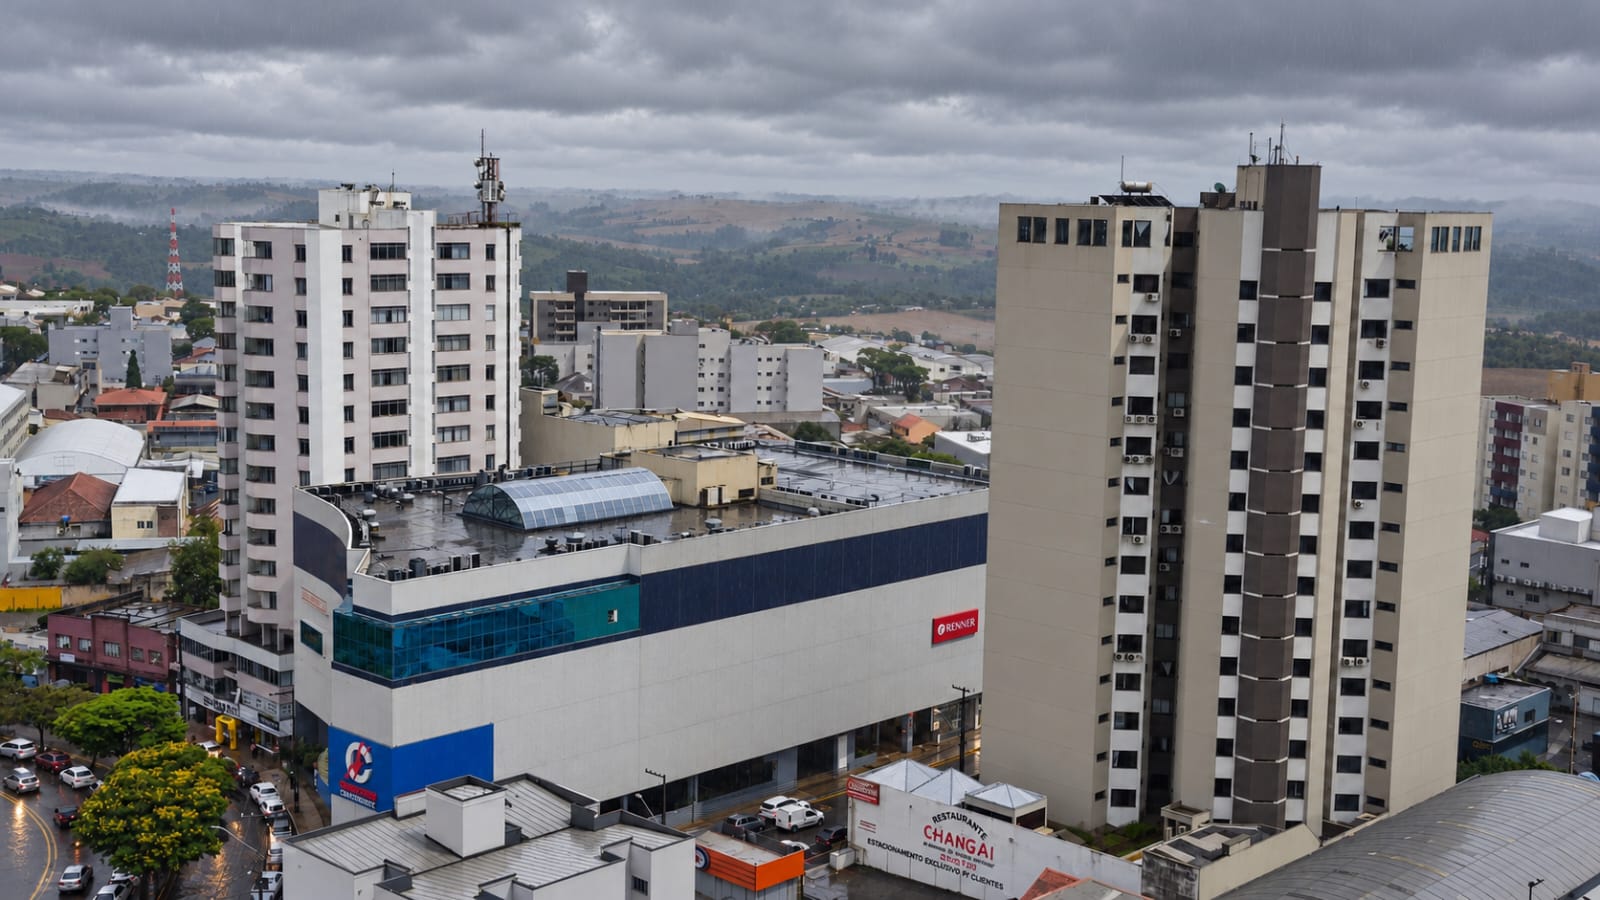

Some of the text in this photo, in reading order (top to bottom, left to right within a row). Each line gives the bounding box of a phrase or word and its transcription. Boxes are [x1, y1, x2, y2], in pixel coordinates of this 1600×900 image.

[946, 618, 976, 632] RENNER
[932, 811, 988, 840] RESTAURANTE
[923, 824, 994, 860] CHANGAI
[867, 837, 924, 862] ESTACIONAMENTO
[924, 857, 961, 875] EXCLUSIVO
[970, 873, 1004, 890] CLIENTES
